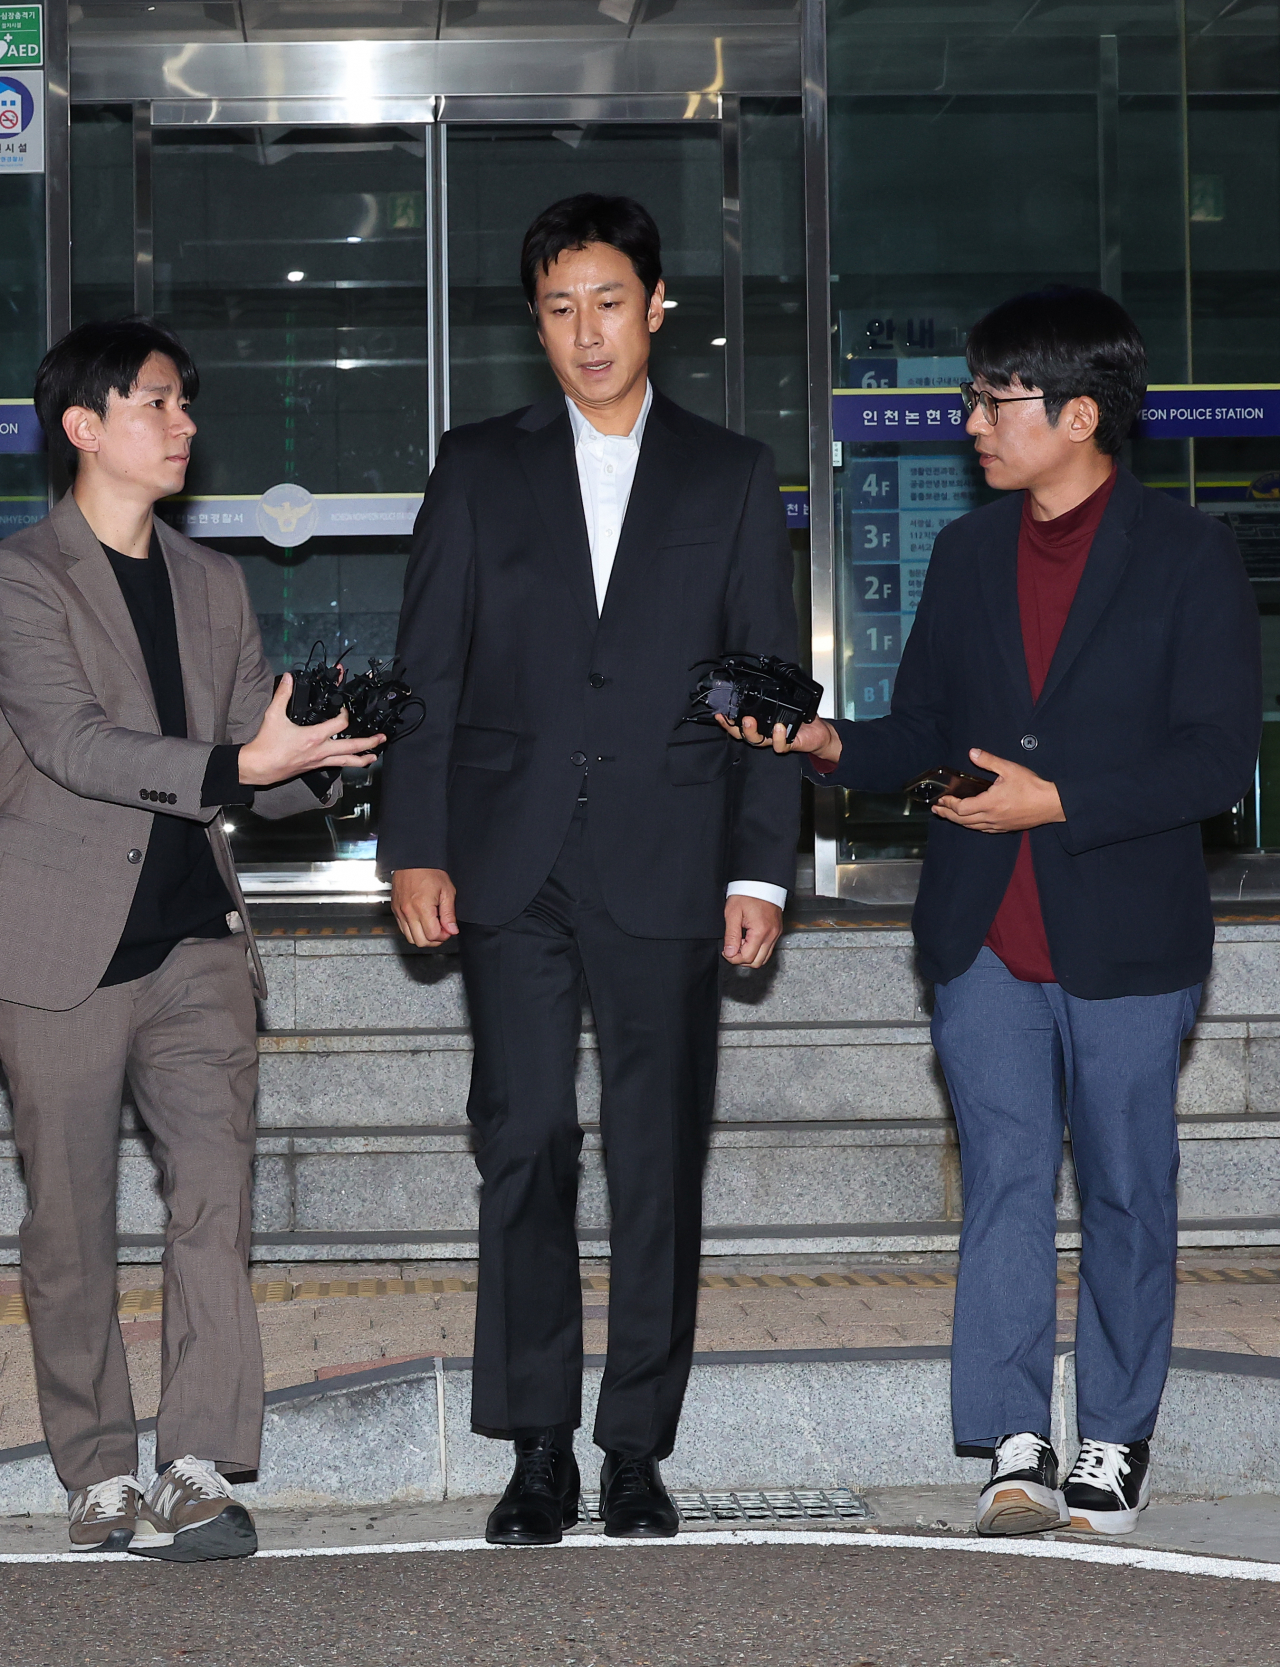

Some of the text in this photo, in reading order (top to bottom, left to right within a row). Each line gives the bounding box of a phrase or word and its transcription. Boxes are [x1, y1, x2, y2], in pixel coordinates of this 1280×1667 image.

[0, 12, 35, 20] 심장충격기
[7, 44, 39, 57] AED
[0, 143, 27, 153] 시설
[1170, 408, 1212, 420] POLICE
[1215, 408, 1264, 420] STATION
[862, 473, 890, 497] 4F
[864, 525, 891, 549] 3F
[864, 576, 891, 600] 2F
[866, 628, 892, 651] 1F
[864, 678, 891, 703] B1
